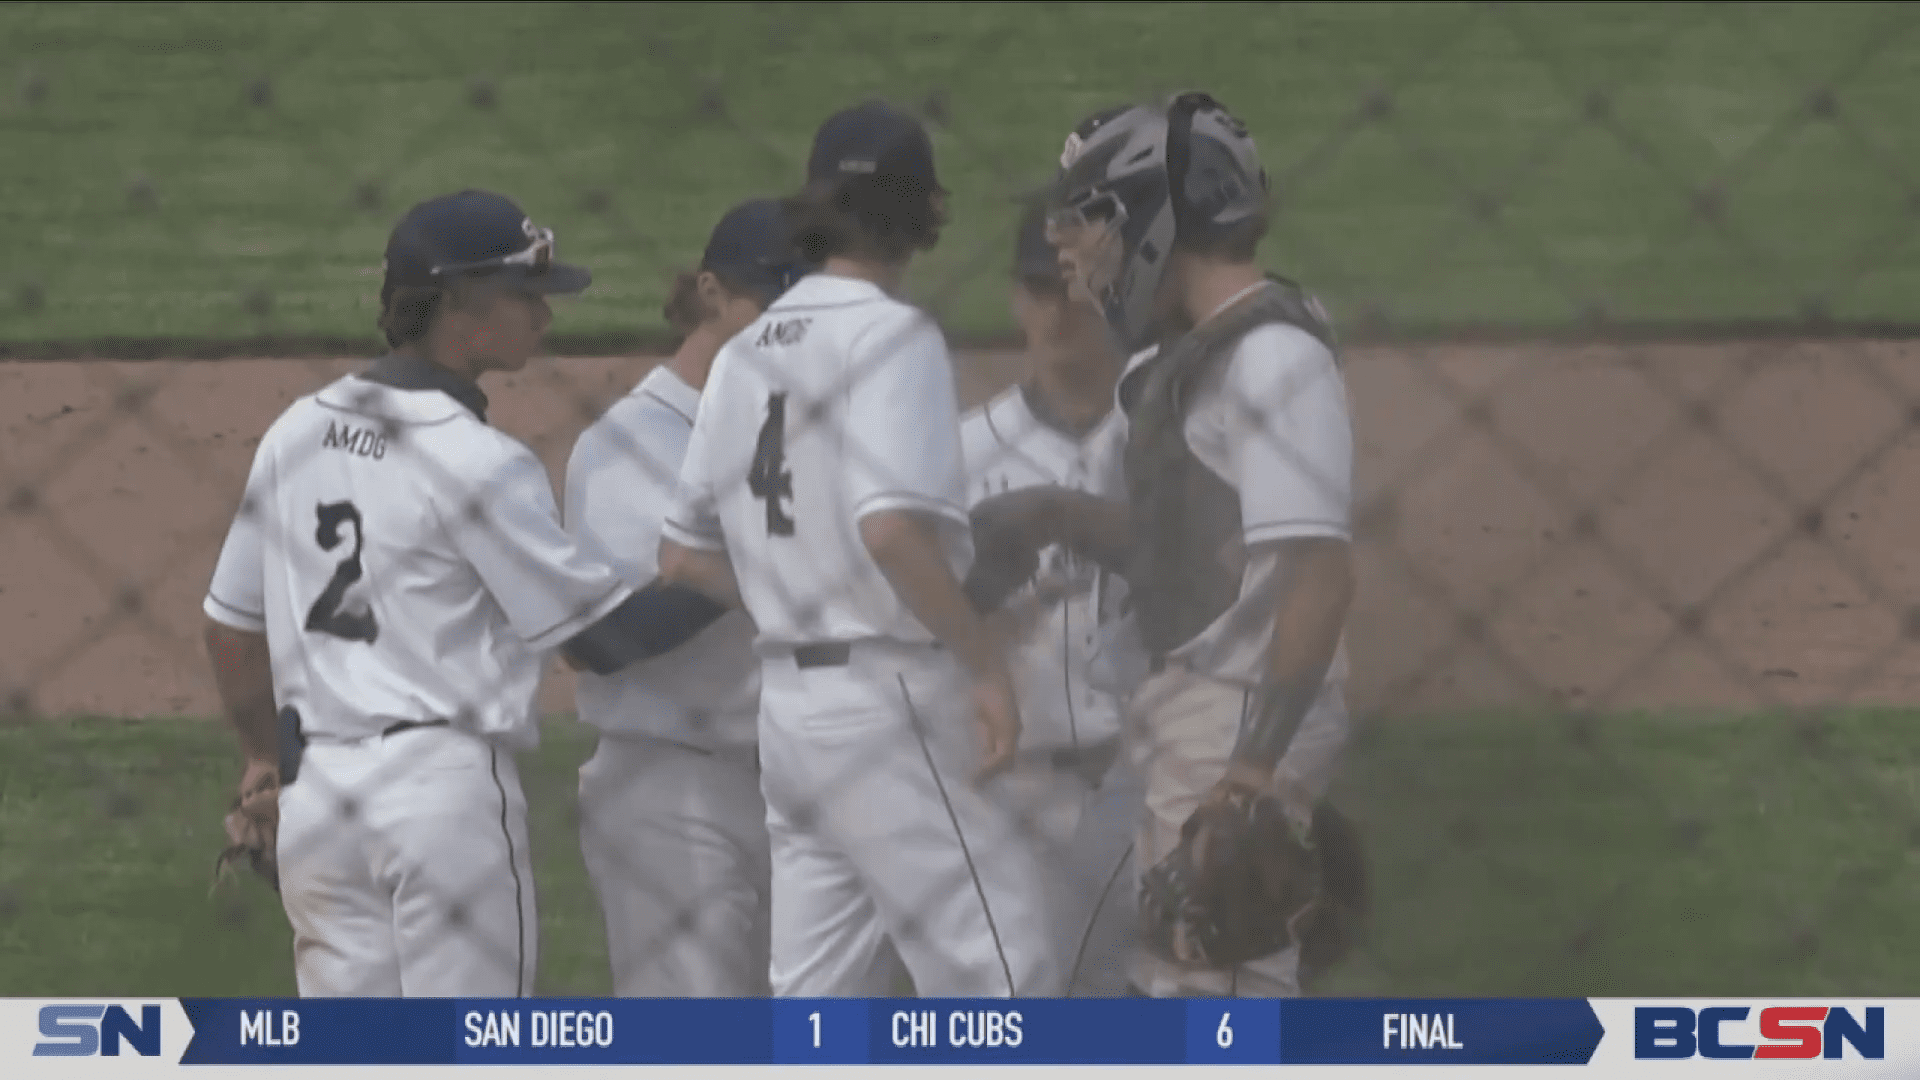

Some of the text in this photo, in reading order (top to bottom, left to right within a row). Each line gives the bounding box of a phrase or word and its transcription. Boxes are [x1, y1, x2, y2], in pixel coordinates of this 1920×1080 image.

[321, 419, 386, 462] AMDG
[746, 391, 795, 539] 4
[303, 498, 379, 645] 2
